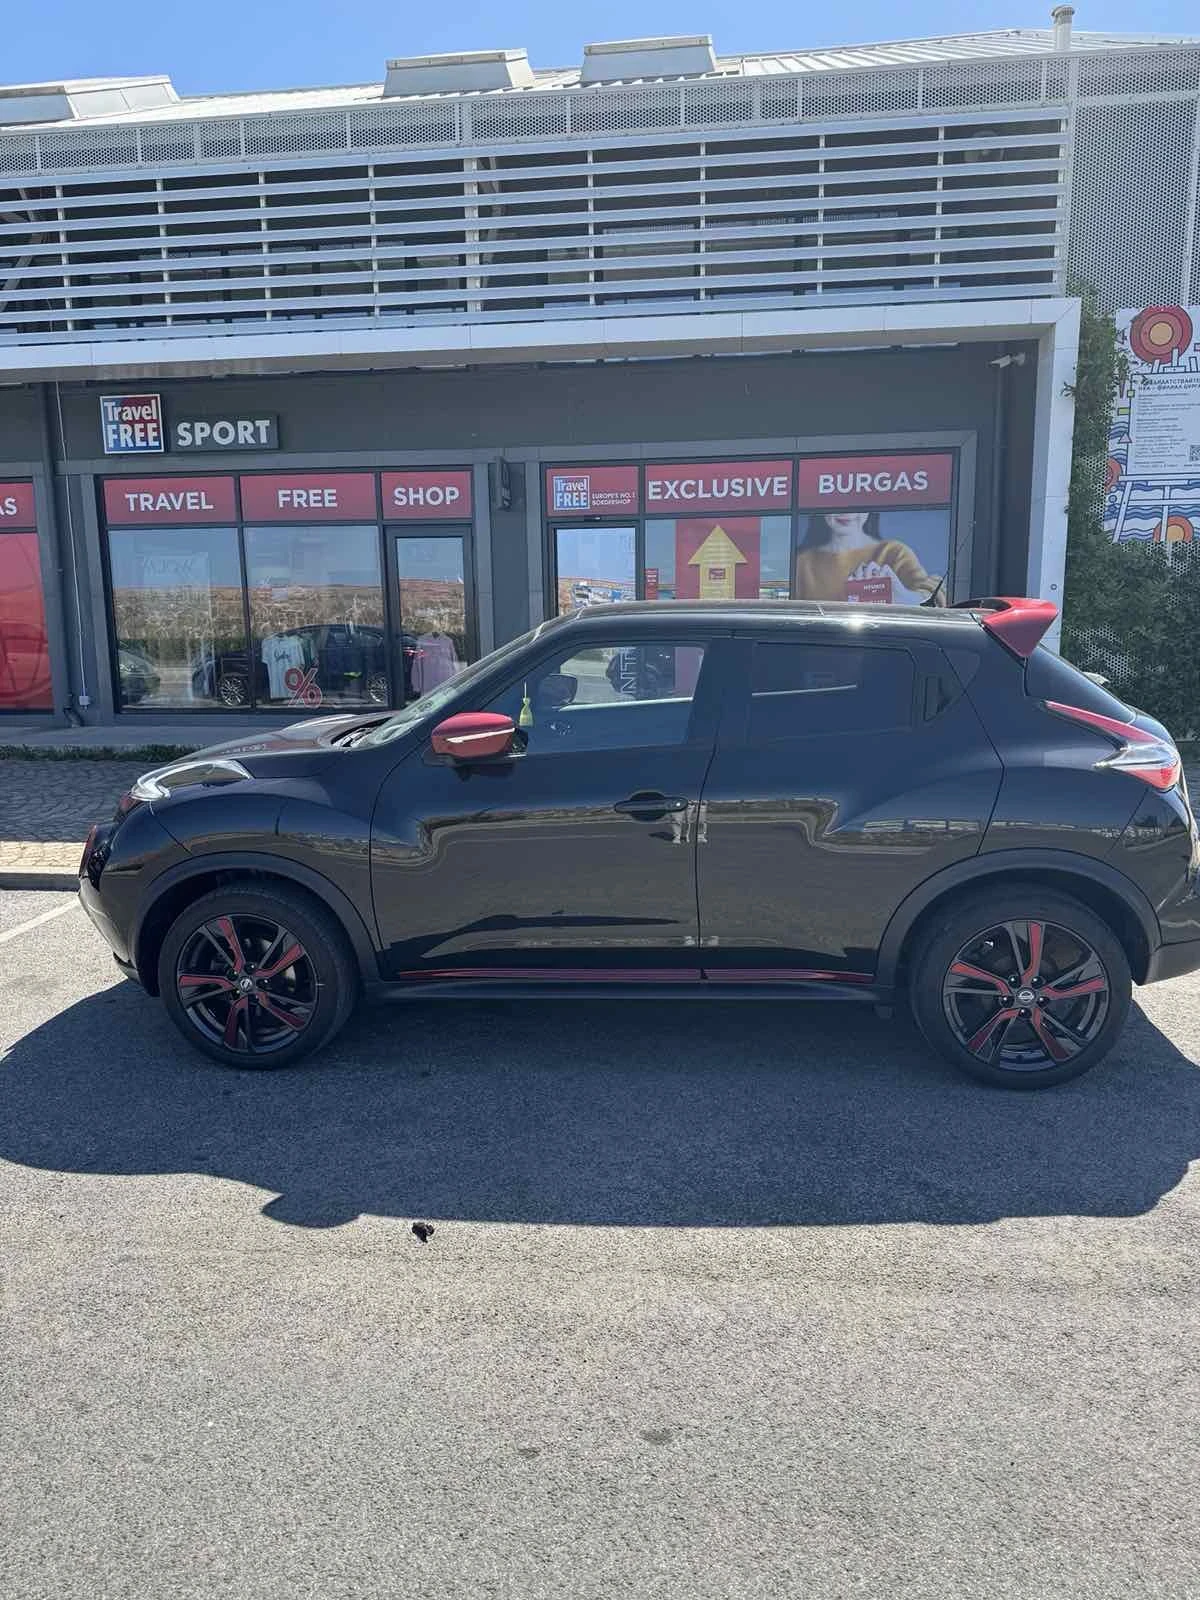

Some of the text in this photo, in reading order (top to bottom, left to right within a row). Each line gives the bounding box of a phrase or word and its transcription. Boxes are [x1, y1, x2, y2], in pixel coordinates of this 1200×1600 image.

[104, 399, 158, 422] Travel
[106, 422, 160, 448] FREE
[177, 420, 270, 446] SPORT
[556, 478, 587, 491] Travel
[647, 476, 788, 500] EXCLUSIVE
[818, 471, 929, 494] BURGAS
[125, 491, 214, 511] TRAVEL
[278, 489, 338, 508] FREE
[393, 486, 460, 506] SHOP
[556, 491, 587, 507] FREE
[0, 497, 17, 516] S
